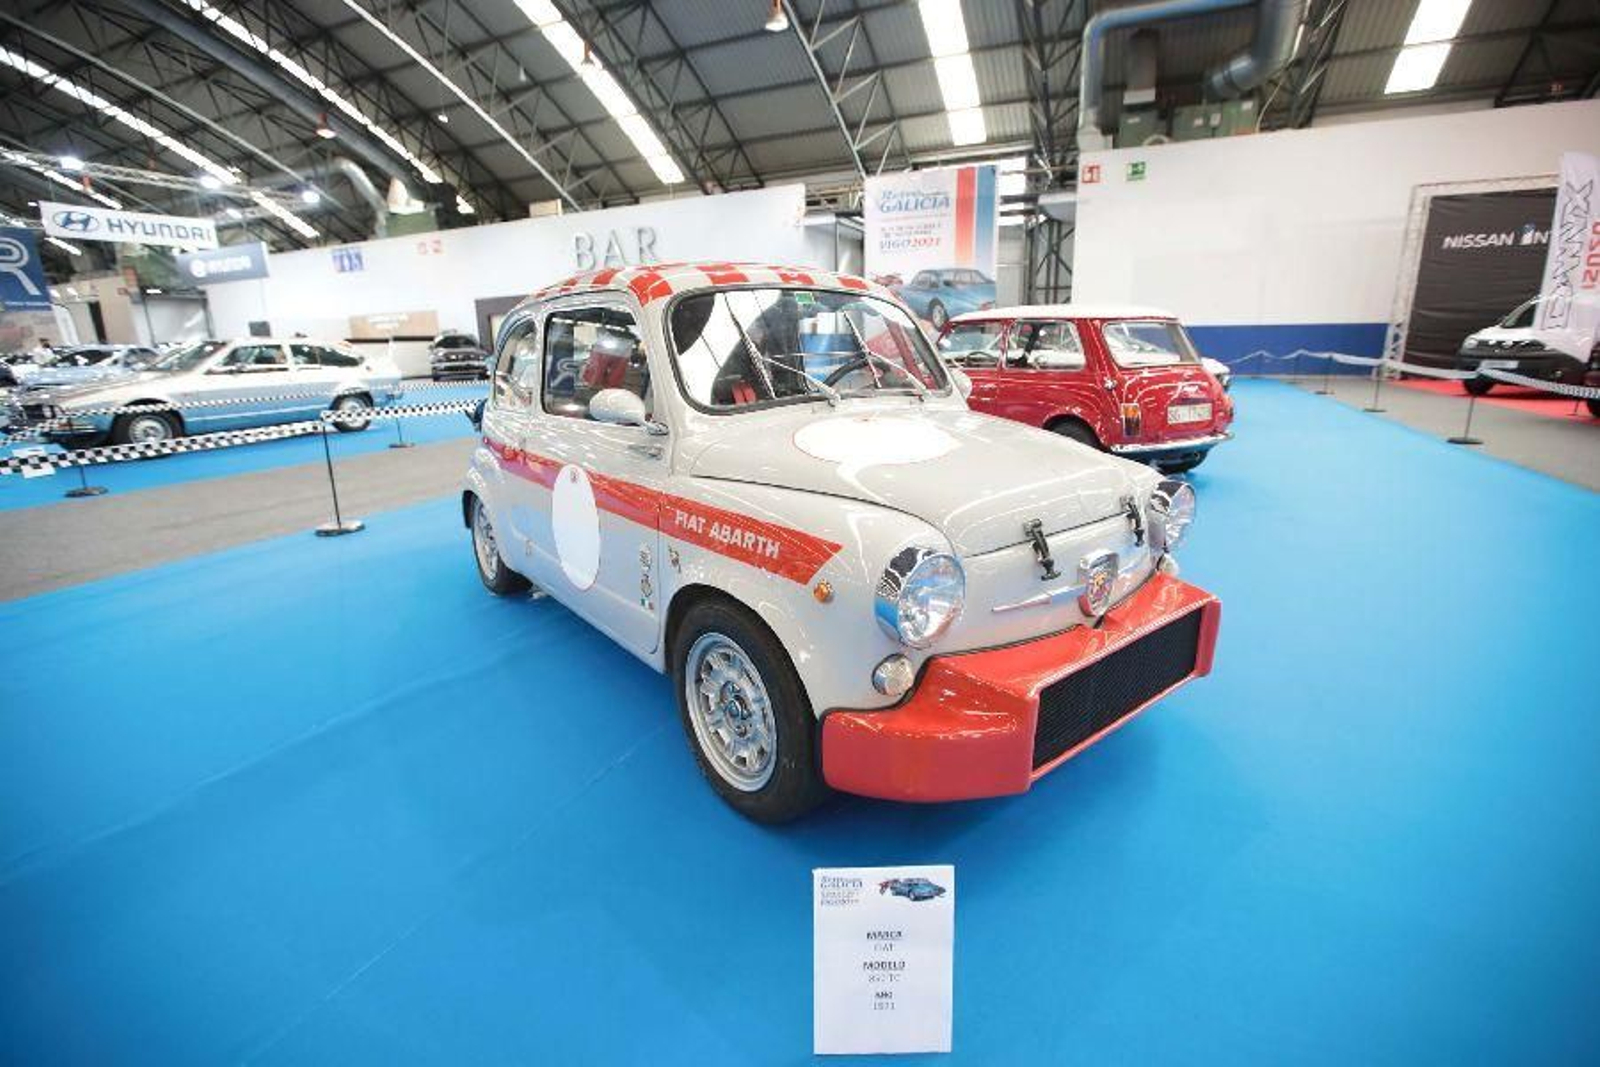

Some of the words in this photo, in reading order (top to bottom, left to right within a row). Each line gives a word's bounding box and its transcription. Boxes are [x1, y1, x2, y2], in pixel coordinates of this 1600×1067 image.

[881, 197, 949, 213] GALICIA
[106, 218, 212, 242] HYUNDAI
[1443, 232, 1514, 248] NISSAN
[574, 226, 661, 271] BAR
[674, 510, 706, 533] FIAT
[710, 523, 780, 558] ABARTH
[866, 930, 902, 940] MARCA
[863, 961, 906, 971] MODELO
